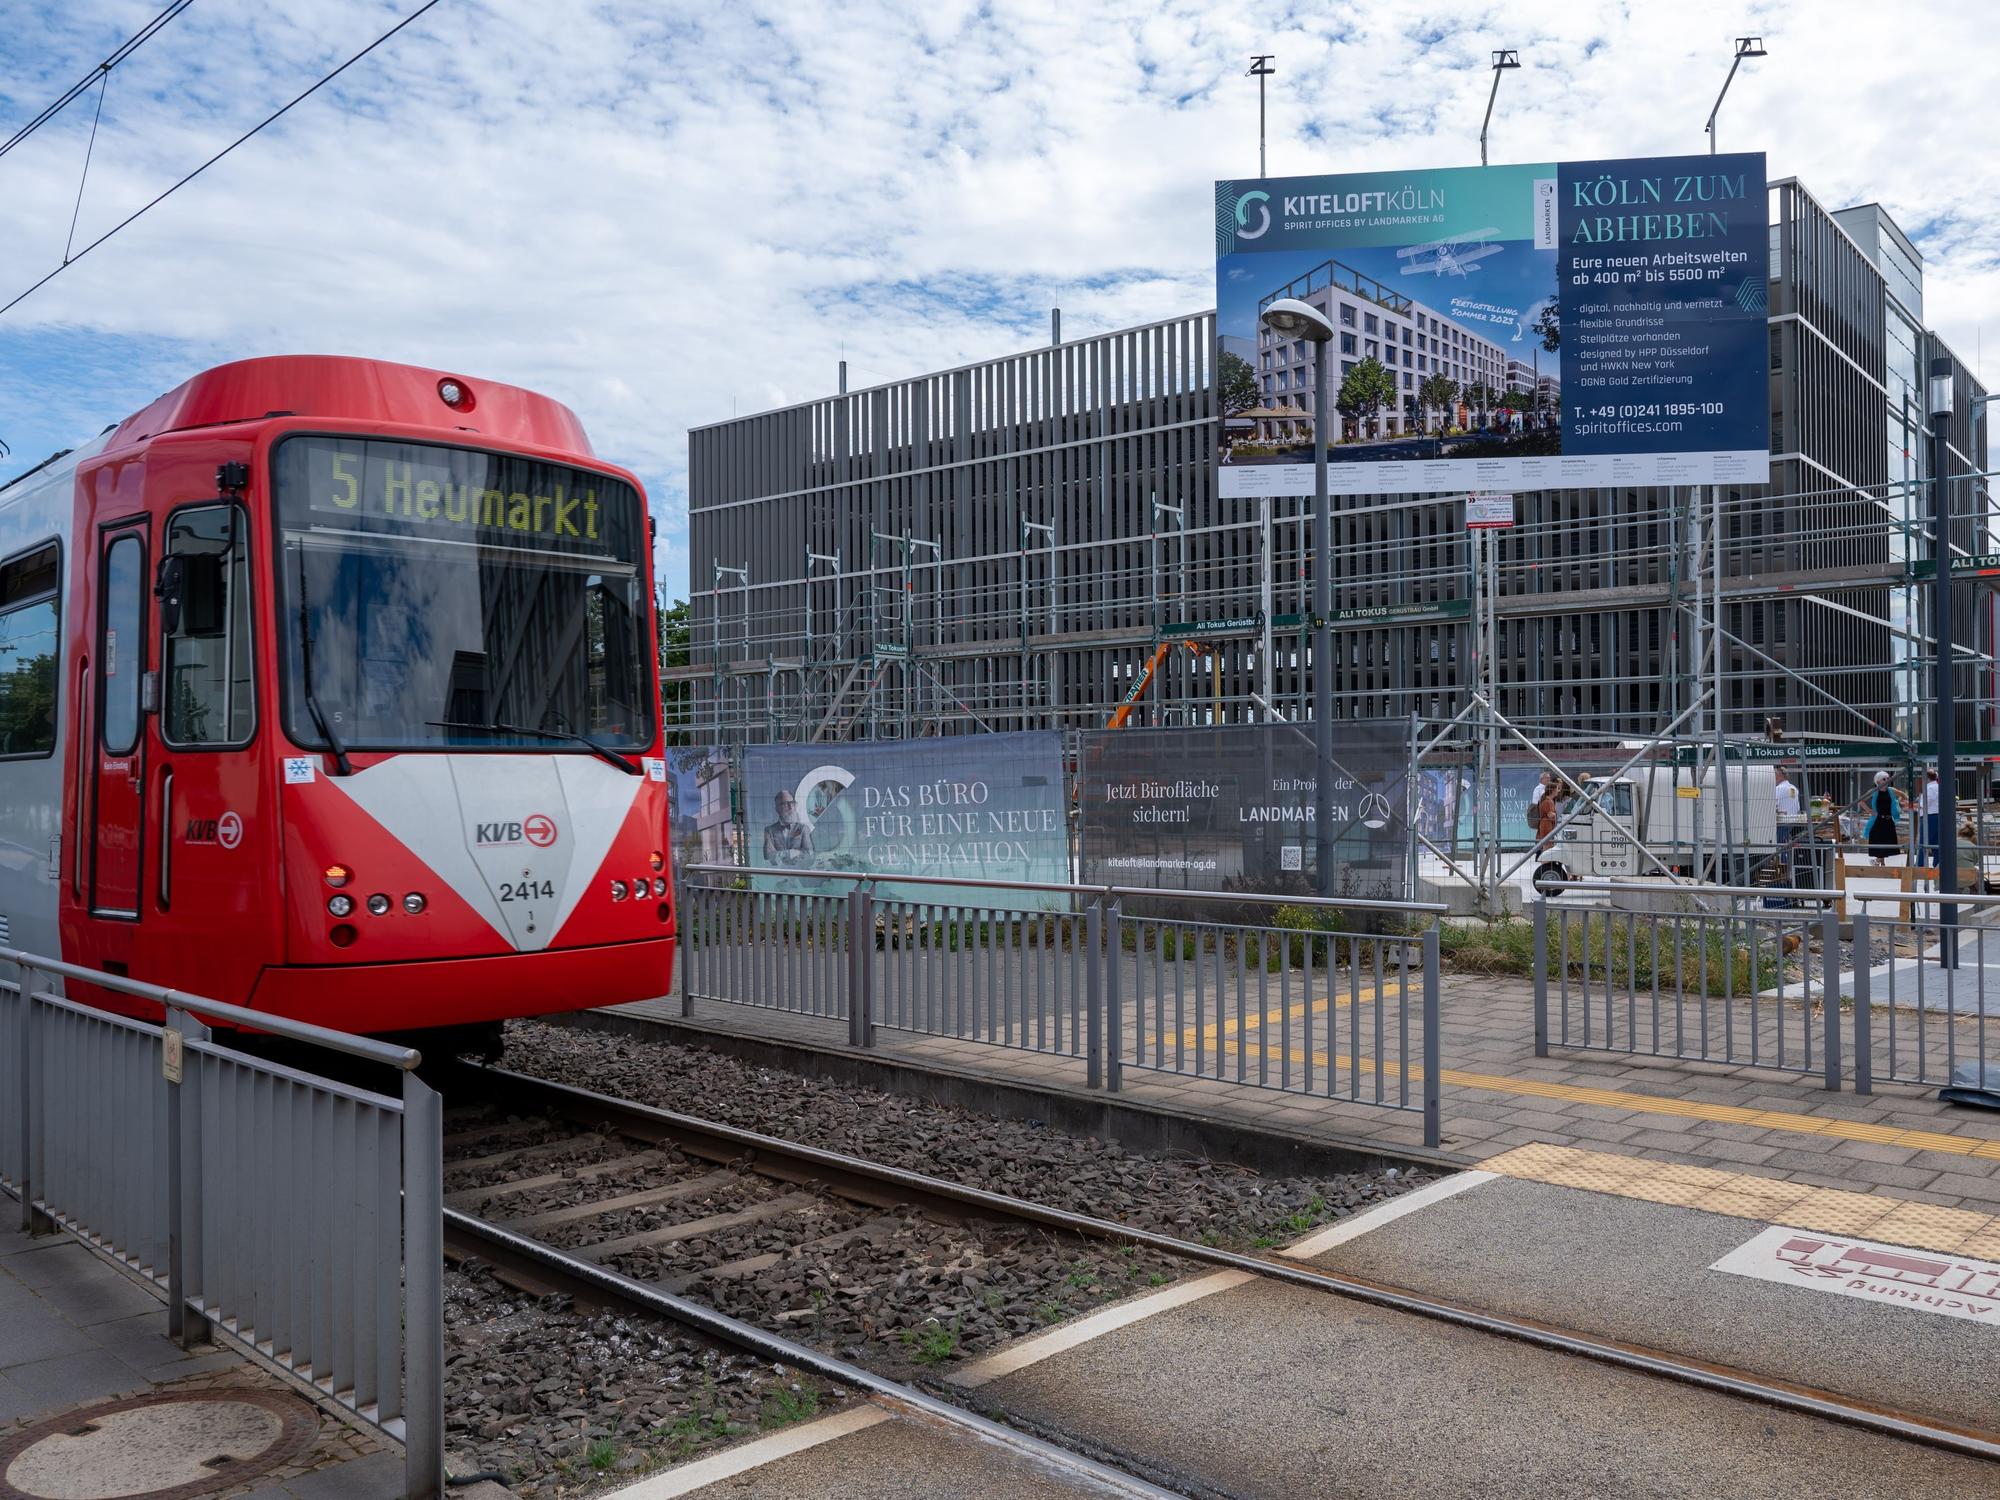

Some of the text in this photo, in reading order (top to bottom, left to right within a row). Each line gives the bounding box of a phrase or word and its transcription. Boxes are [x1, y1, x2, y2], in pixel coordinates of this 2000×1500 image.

[1573, 174, 1747, 207] KÖLN ZUM
[1284, 185, 1445, 216] KITELOFTKÖLN
[1284, 215, 1445, 230] SPIRIT OFFICES BY LANDMARKEN AG
[1572, 212, 1728, 244] ABHEBEN
[1573, 251, 1747, 269] Eure neuen Arbeitswelten
[1573, 267, 1725, 285] ab 400 m² bis 5500 m²
[1451, 298, 1518, 316] FERTIGSTELLUNG
[1451, 308, 1487, 321] SOMMER
[1580, 300, 1723, 314] digital, nachhaltig und vernetzt
[1580, 317, 1664, 328] flexible Grundrisse
[1580, 332, 1680, 345] Stellplätze vorhanden
[1581, 346, 1709, 360] designed by HPP Düsseldorf
[1581, 359, 1675, 371] und HWKN New York
[1581, 375, 1693, 386] DGNB Gold Zertifizierung
[1574, 402, 1724, 419] T. +49 (0)241 1895-100
[1575, 420, 1683, 436] spiritoffices.com
[331, 453, 599, 539] 5 Heumarkt
[1951, 556, 2000, 568] ALI TO
[1340, 611, 1354, 619] ALI
[1356, 607, 1387, 617] TOKUS
[1196, 622, 1206, 630] Ali
[1207, 621, 1226, 629] Tokus
[1755, 748, 1785, 756] Tokus
[1787, 746, 1841, 756] Geüstbau
[1106, 780, 1219, 803] Jetzt Bürofläche
[1272, 779, 1290, 791] Ein
[1335, 777, 1355, 790] der
[864, 779, 988, 808] DAS BÜRO
[1133, 805, 1190, 823] sichern!
[1239, 806, 1348, 821] LANDMAREN
[186, 819, 217, 842] KVB
[476, 822, 522, 843] KVB
[864, 810, 1057, 838] FÜR EINE NEUE
[868, 840, 1031, 867] GENERATION
[500, 880, 555, 902] 2414
[1846, 1279, 1993, 1315] Achtung
